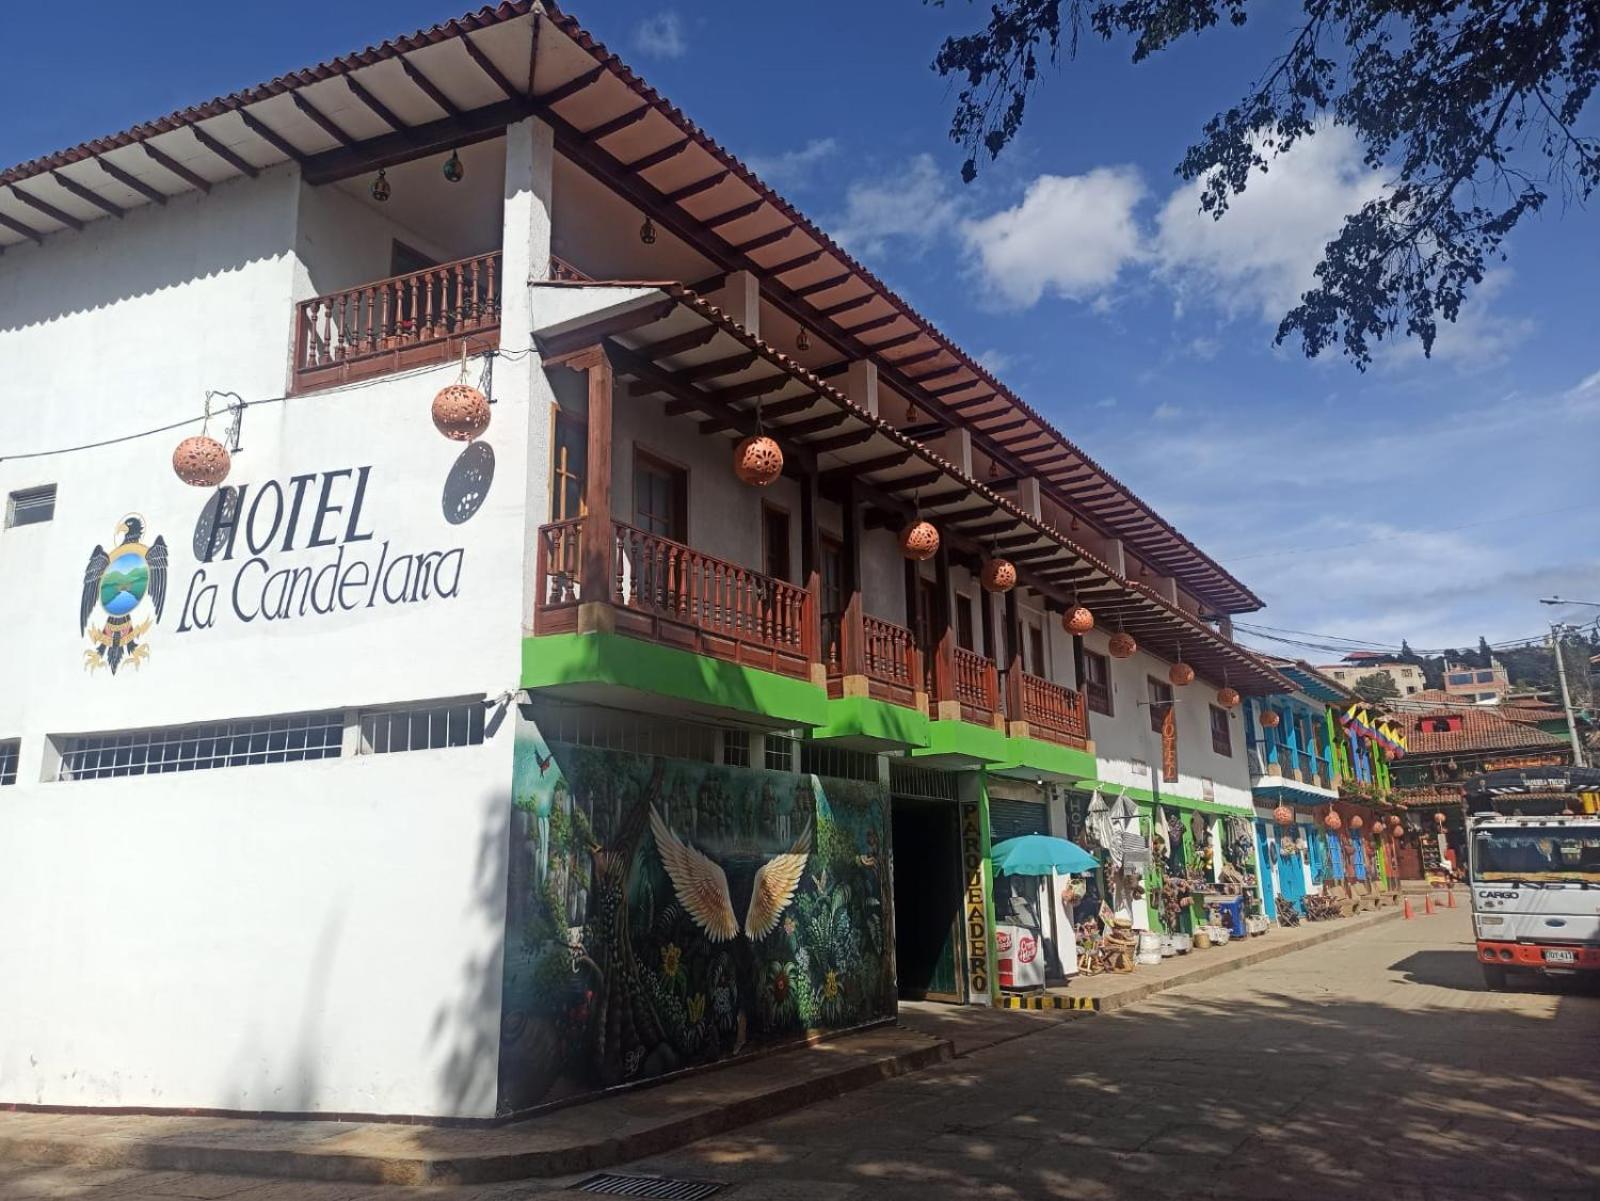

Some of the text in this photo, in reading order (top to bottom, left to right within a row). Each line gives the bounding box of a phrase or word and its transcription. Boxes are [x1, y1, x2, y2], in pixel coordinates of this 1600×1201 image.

[203, 466, 374, 564] HOTEL
[963, 804, 987, 993] PARQUEADERO
[1478, 890, 1519, 899] CARGO
